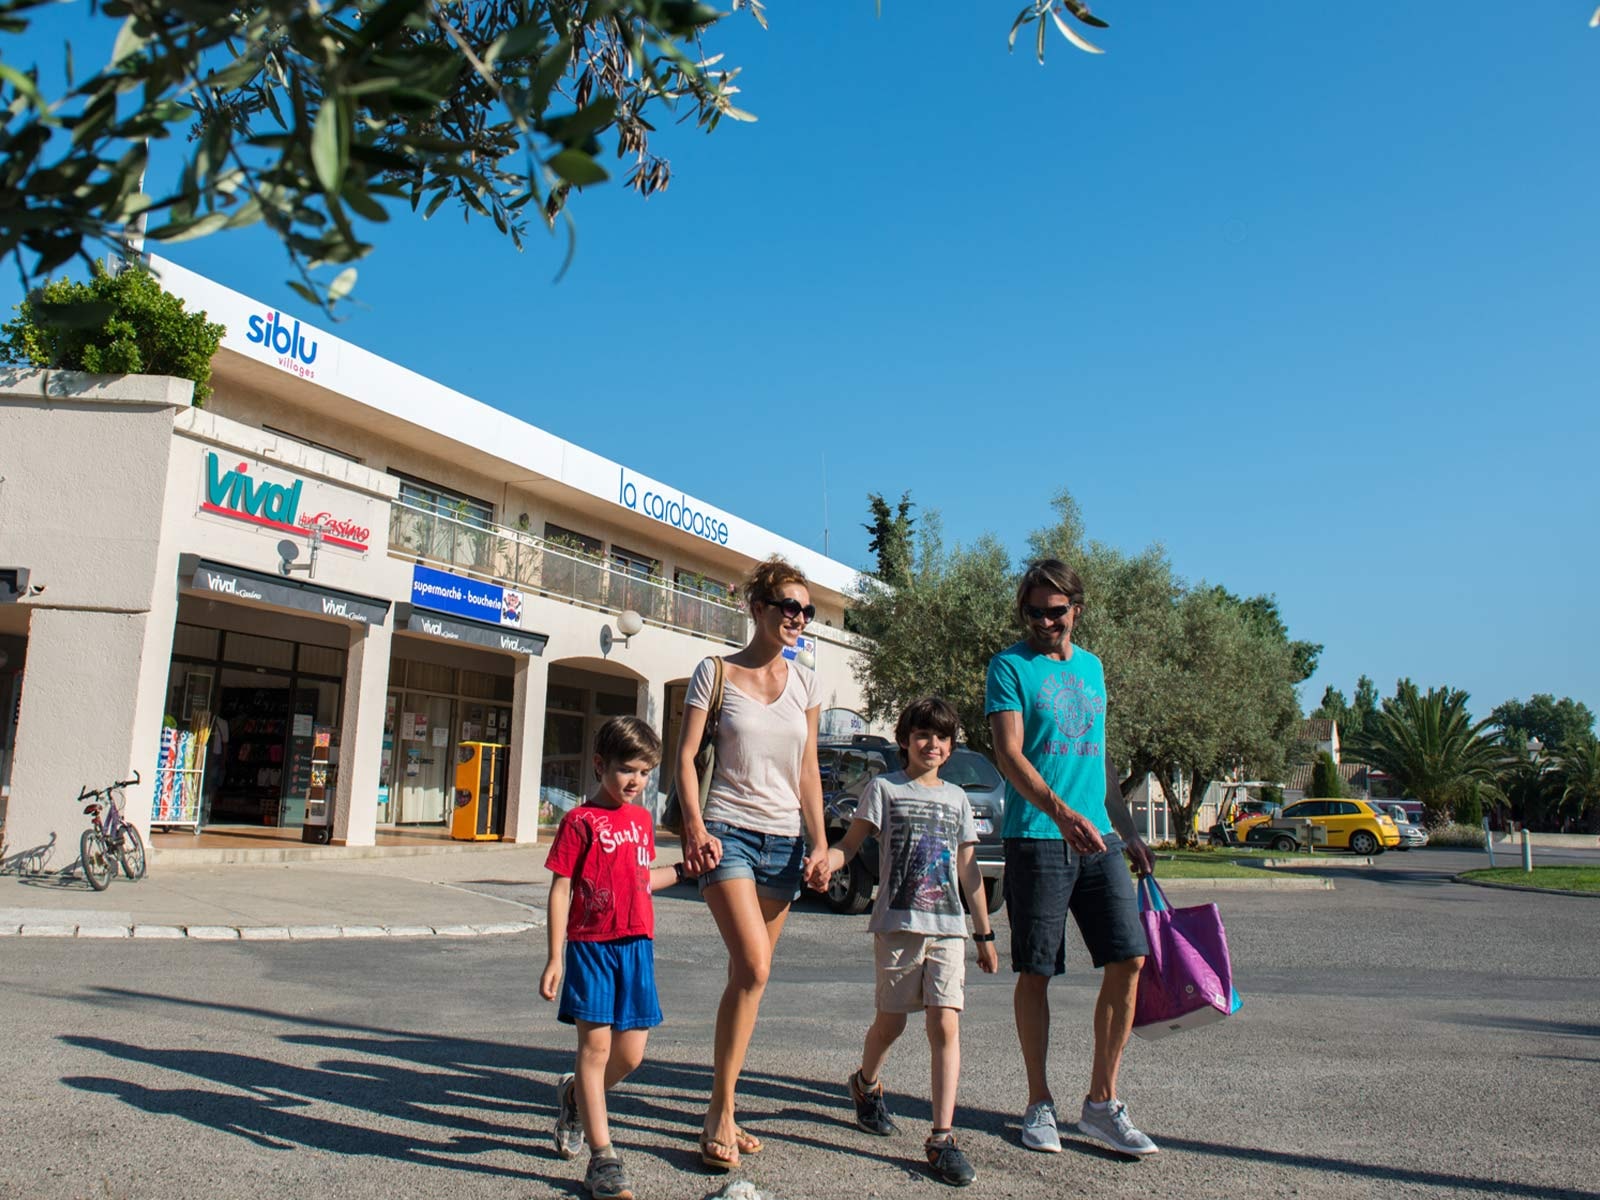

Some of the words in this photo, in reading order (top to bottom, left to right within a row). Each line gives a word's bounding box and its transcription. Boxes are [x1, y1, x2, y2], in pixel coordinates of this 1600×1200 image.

[246, 311, 317, 364] siblu
[278, 357, 315, 379] villages
[206, 452, 304, 526] Vival
[313, 512, 370, 541] Casino
[619, 467, 637, 510] la
[643, 491, 728, 545] carabasse
[207, 573, 237, 594] Vival
[413, 579, 462, 601] supermarché
[467, 589, 502, 610] boucherie
[322, 597, 347, 618] Vival
[421, 618, 442, 636] Vival
[1043, 739, 1069, 756] NEW
